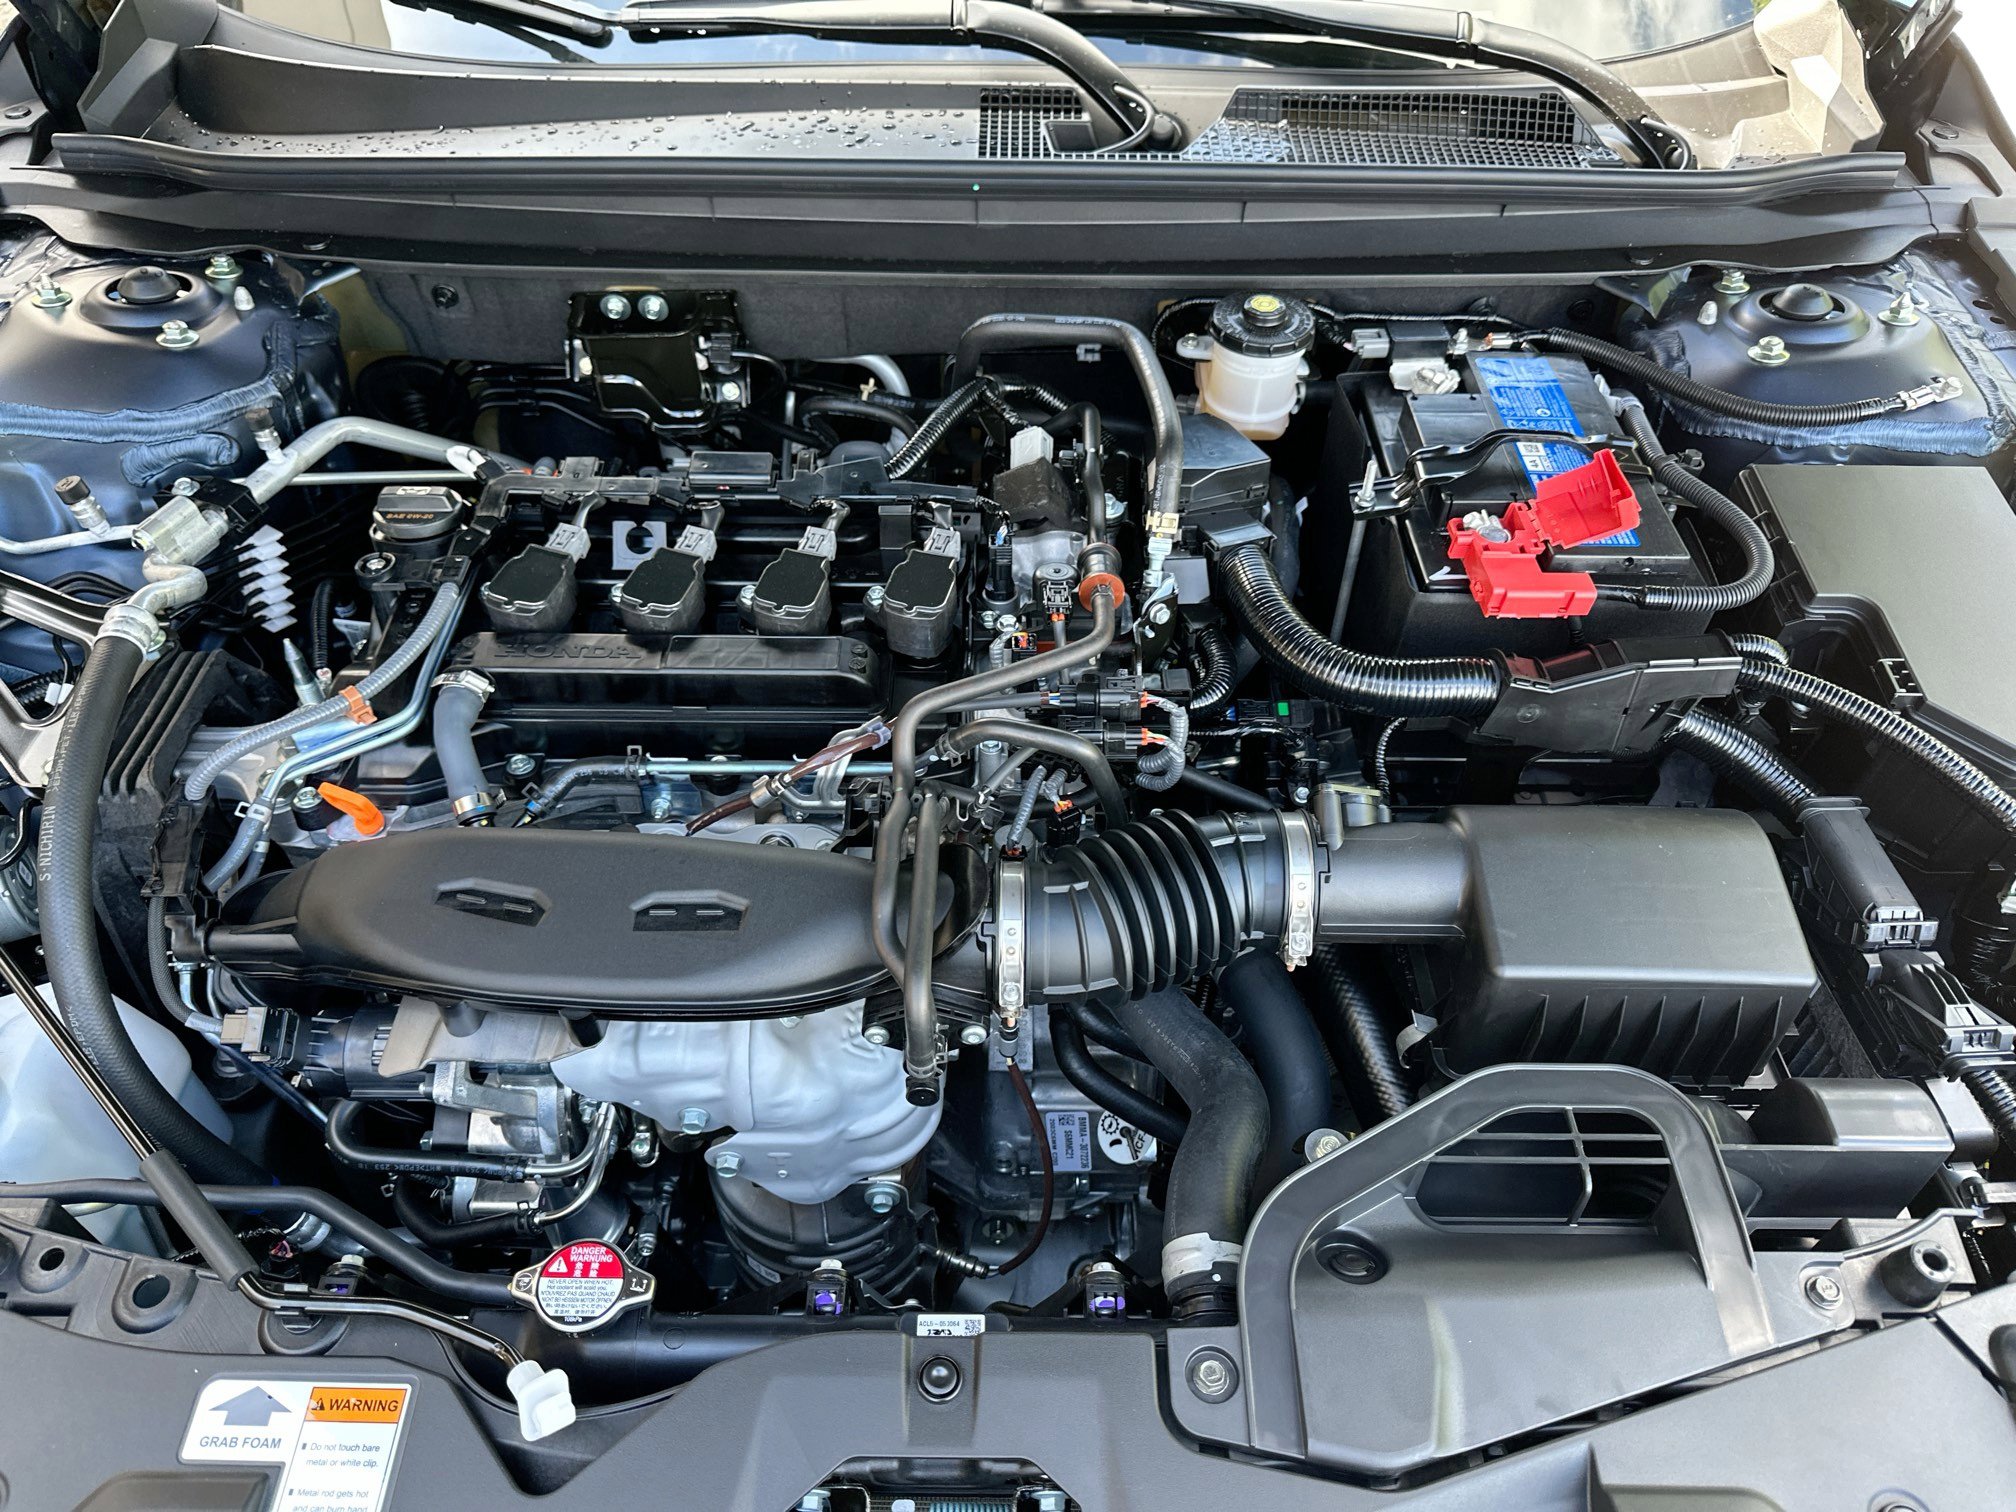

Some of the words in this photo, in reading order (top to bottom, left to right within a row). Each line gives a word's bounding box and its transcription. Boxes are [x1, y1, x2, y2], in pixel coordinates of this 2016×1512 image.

[494, 644, 641, 659] HONDA
[571, 1246, 607, 1254] DANGER
[570, 1254, 613, 1262] WARNUNG
[328, 1399, 399, 1412] WARNING
[199, 1436, 239, 1448] GRAB
[242, 1437, 282, 1449] FOAM
[310, 1442, 322, 1451] Do
[324, 1443, 337, 1451] not
[338, 1443, 360, 1452] touch
[362, 1444, 380, 1452] bare
[306, 1458, 328, 1466] metal
[340, 1459, 361, 1467] white
[362, 1459, 379, 1468] clip.
[297, 1488, 319, 1497] Metal
[320, 1489, 335, 1498] rod
[336, 1490, 353, 1499] gets
[355, 1490, 369, 1498] hot
